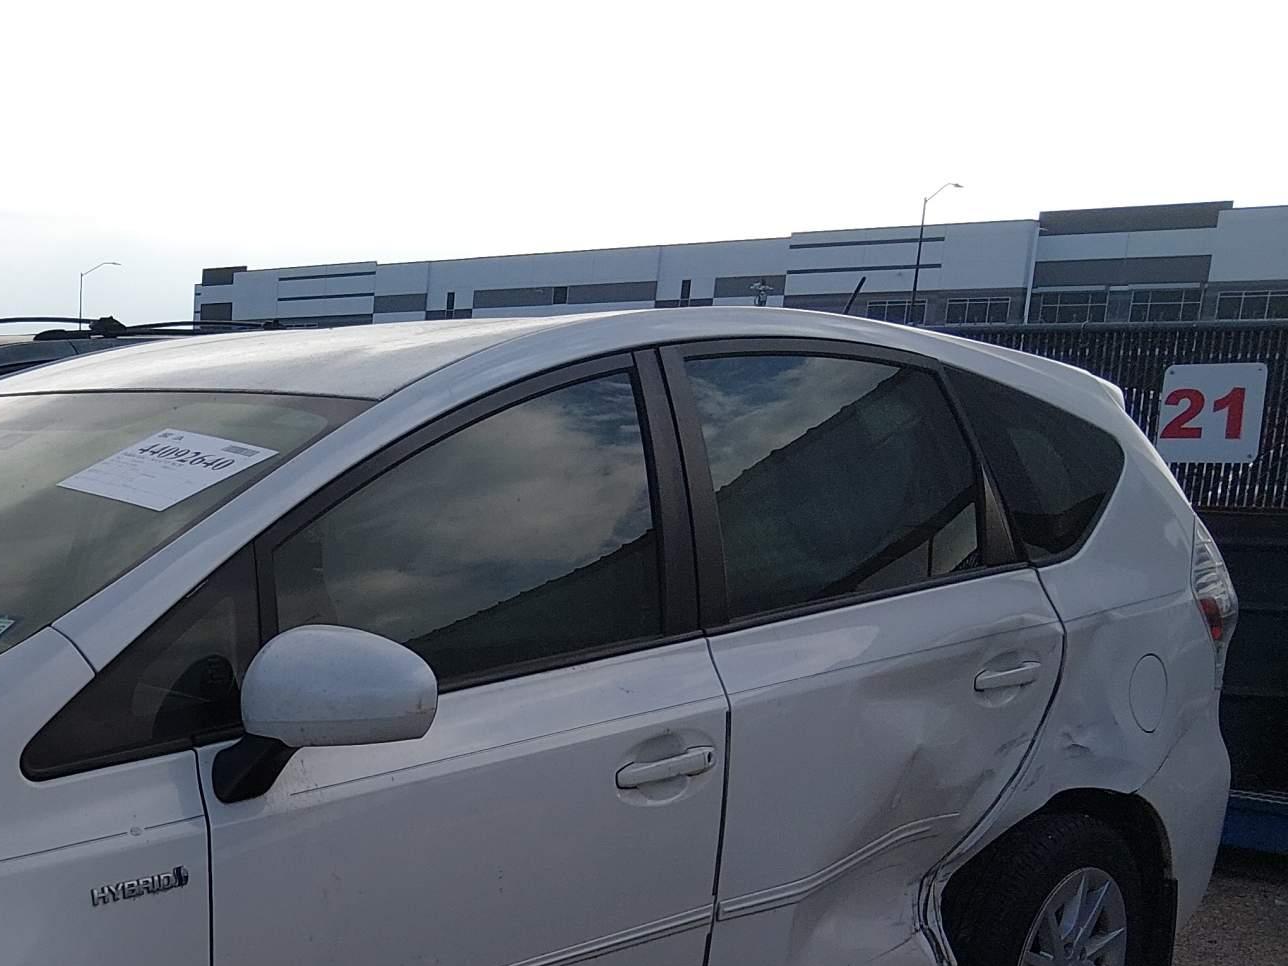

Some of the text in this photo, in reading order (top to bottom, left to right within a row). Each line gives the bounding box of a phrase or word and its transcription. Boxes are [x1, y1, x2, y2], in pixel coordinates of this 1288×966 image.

[1159, 386, 1247, 440] 21
[139, 442, 236, 471] 44092640
[90, 873, 175, 907] HYBRID
